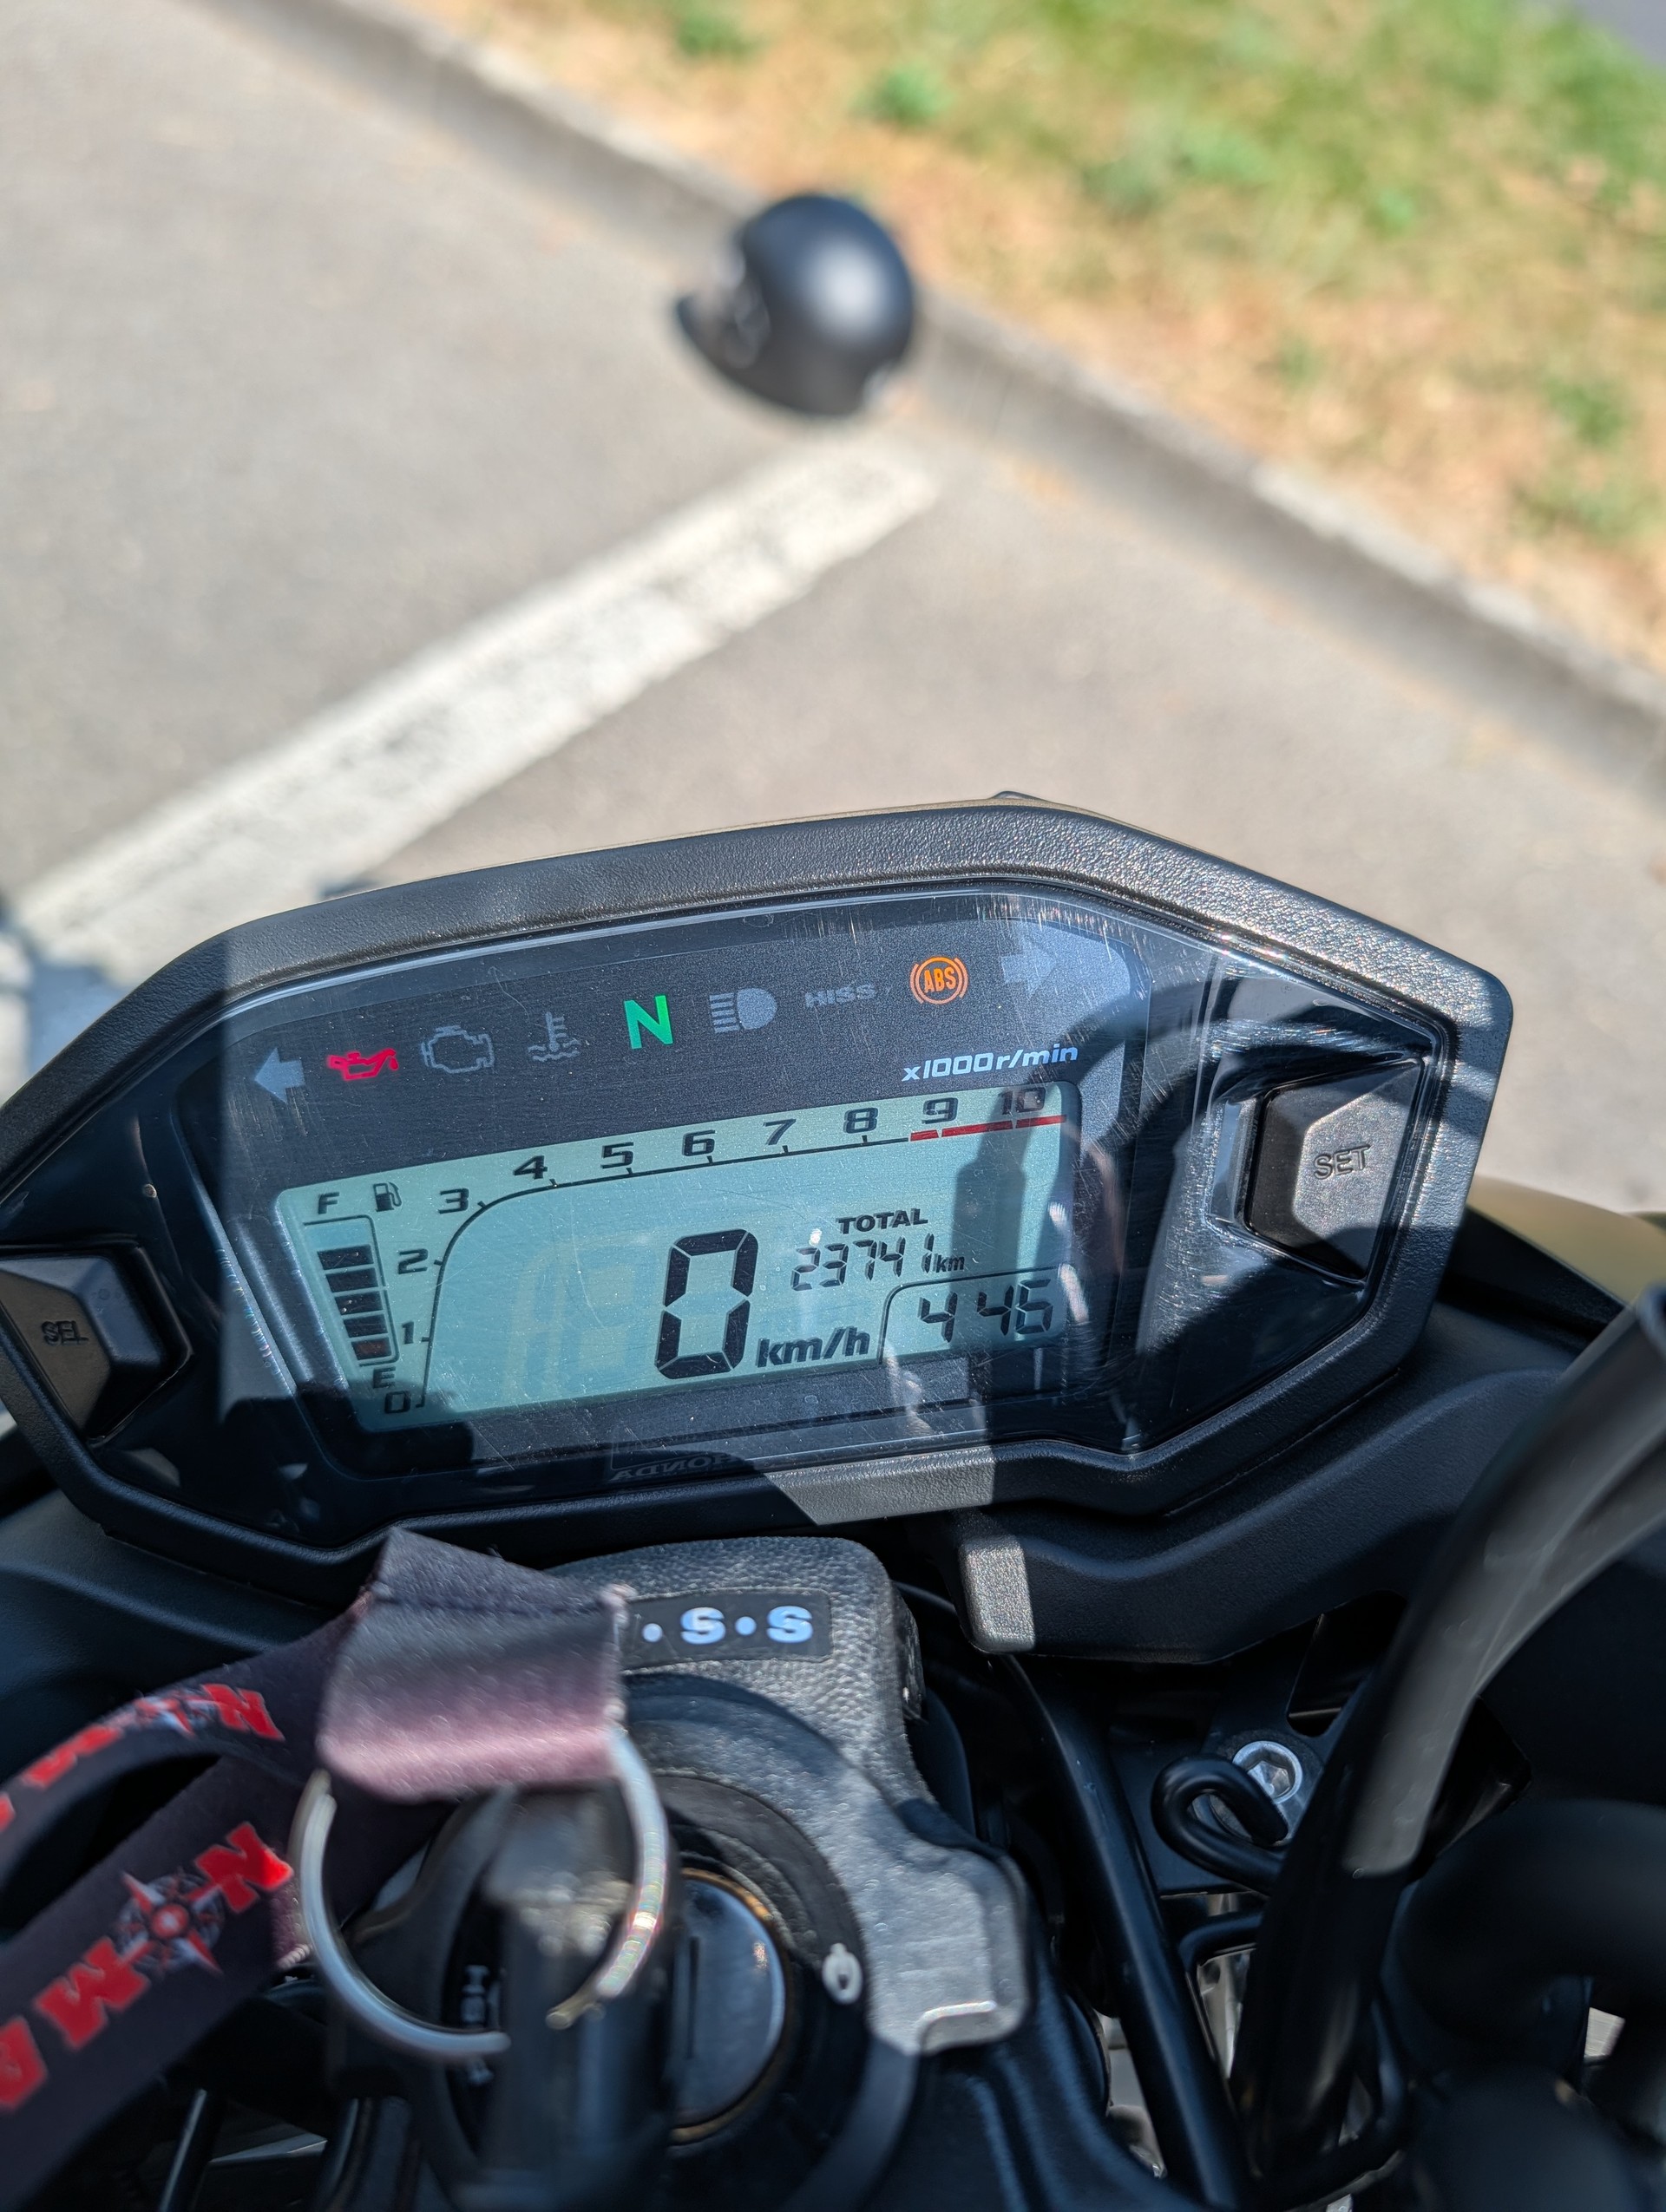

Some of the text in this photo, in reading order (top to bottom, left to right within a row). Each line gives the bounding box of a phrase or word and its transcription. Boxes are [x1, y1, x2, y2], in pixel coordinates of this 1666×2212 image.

[923, 966, 956, 992] ABS
[804, 982, 877, 1009] HISS
[624, 994, 673, 1049] N
[922, 1096, 959, 1124] 9
[998, 1089, 1046, 1116] 10
[762, 1118, 797, 1146] 7
[843, 1107, 879, 1134] 8
[601, 1142, 634, 1169] 5
[683, 1129, 717, 1157] 6
[512, 1155, 548, 1179] 4
[1314, 1143, 1371, 1181] SET
[318, 1192, 340, 1214] F
[437, 1188, 469, 1214] 3
[836, 1207, 928, 1234] TOTAL
[398, 1248, 429, 1274] 2
[655, 1227, 758, 1379] 0
[41, 1319, 89, 1345] SEL
[402, 1321, 415, 1345] 1
[756, 1325, 870, 1368] km/h
[373, 1366, 397, 1388] E
